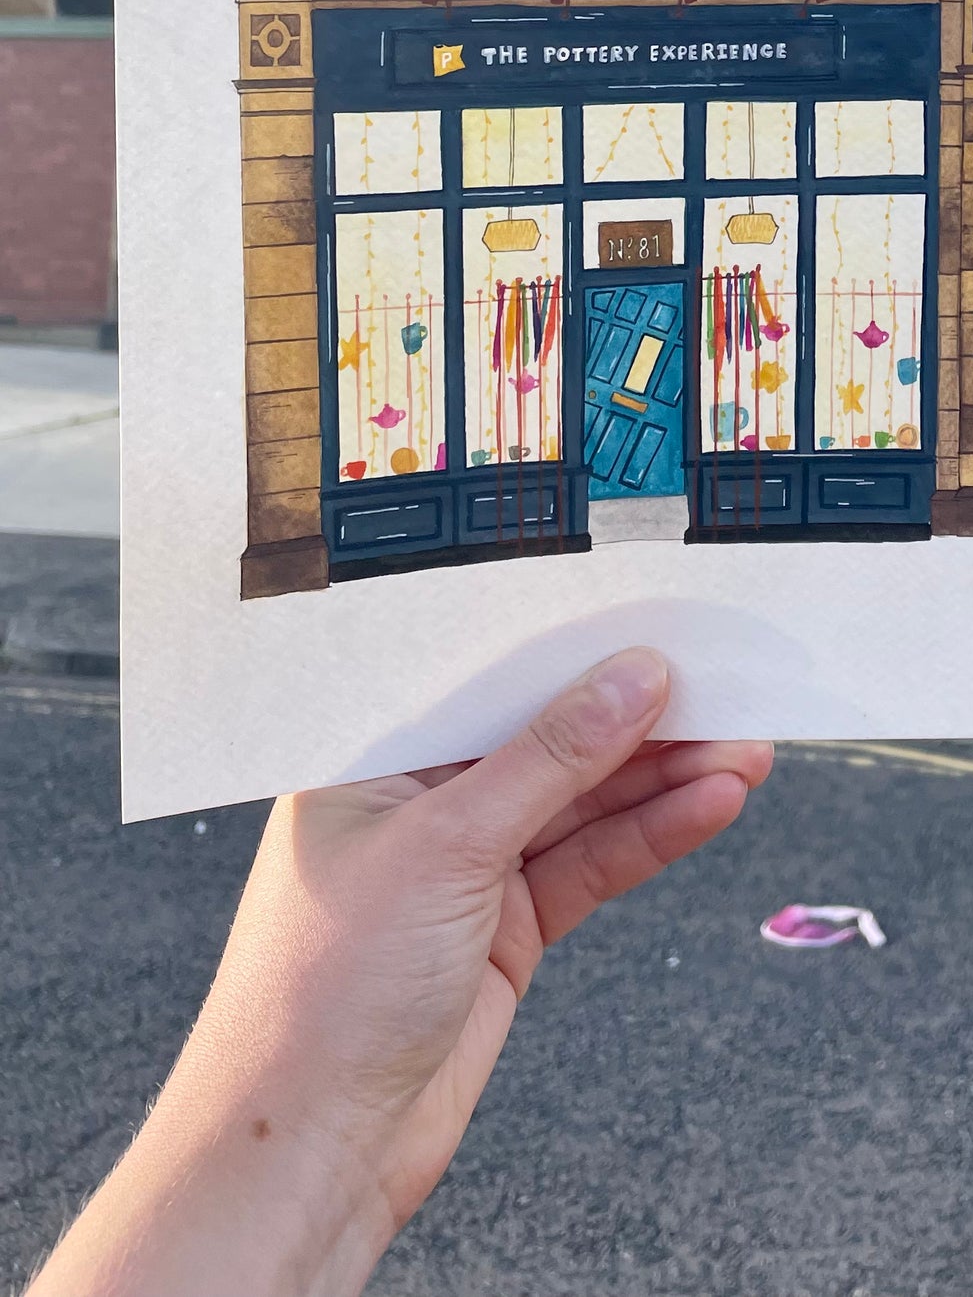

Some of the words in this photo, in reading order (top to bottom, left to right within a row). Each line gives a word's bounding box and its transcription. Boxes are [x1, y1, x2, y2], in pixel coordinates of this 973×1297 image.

[481, 45, 528, 65] THE
[544, 45, 640, 63] POTTERY
[650, 43, 788, 62] EXPERIENCE
